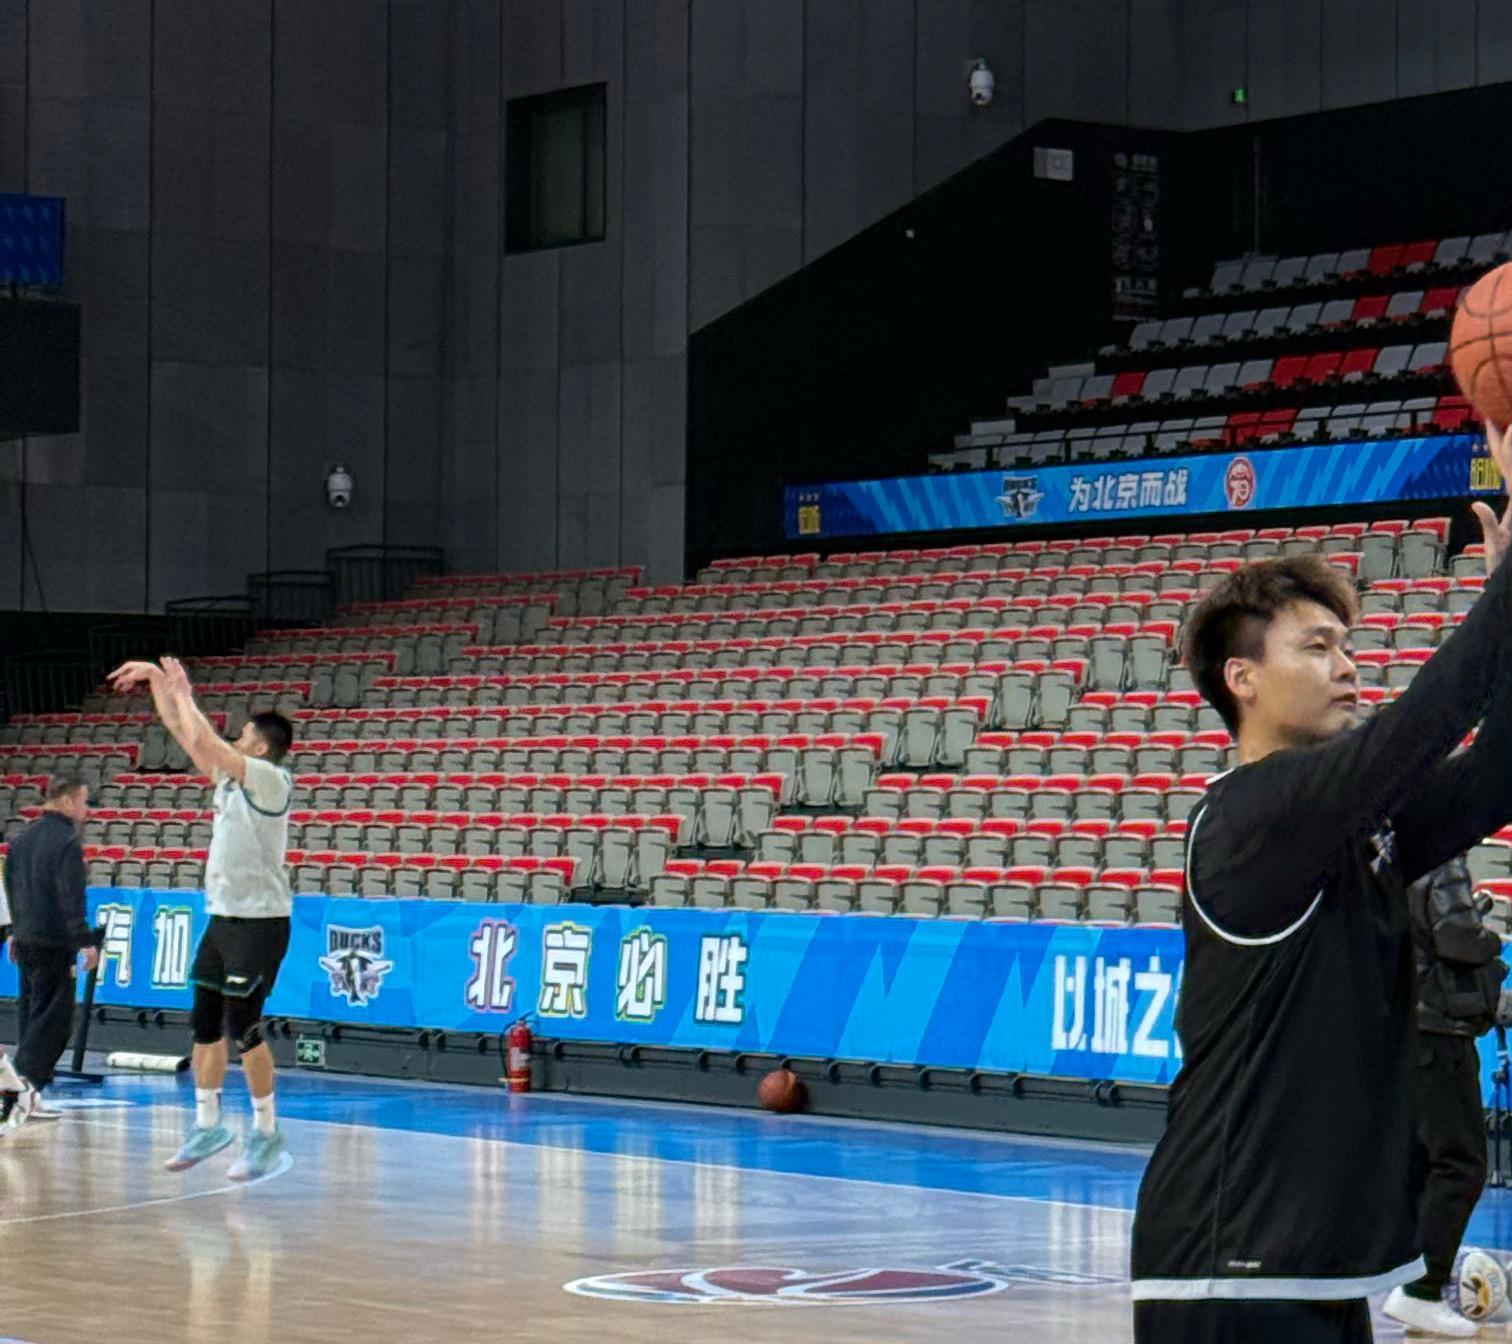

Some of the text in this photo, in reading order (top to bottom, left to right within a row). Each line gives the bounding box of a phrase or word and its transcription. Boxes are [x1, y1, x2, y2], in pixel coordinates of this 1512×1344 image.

[1069, 467, 1189, 513] 为北京而战
[329, 928, 382, 954] DUCKS
[466, 918, 749, 1024] 北京必胜
[1051, 949, 1183, 1058] 以城之
